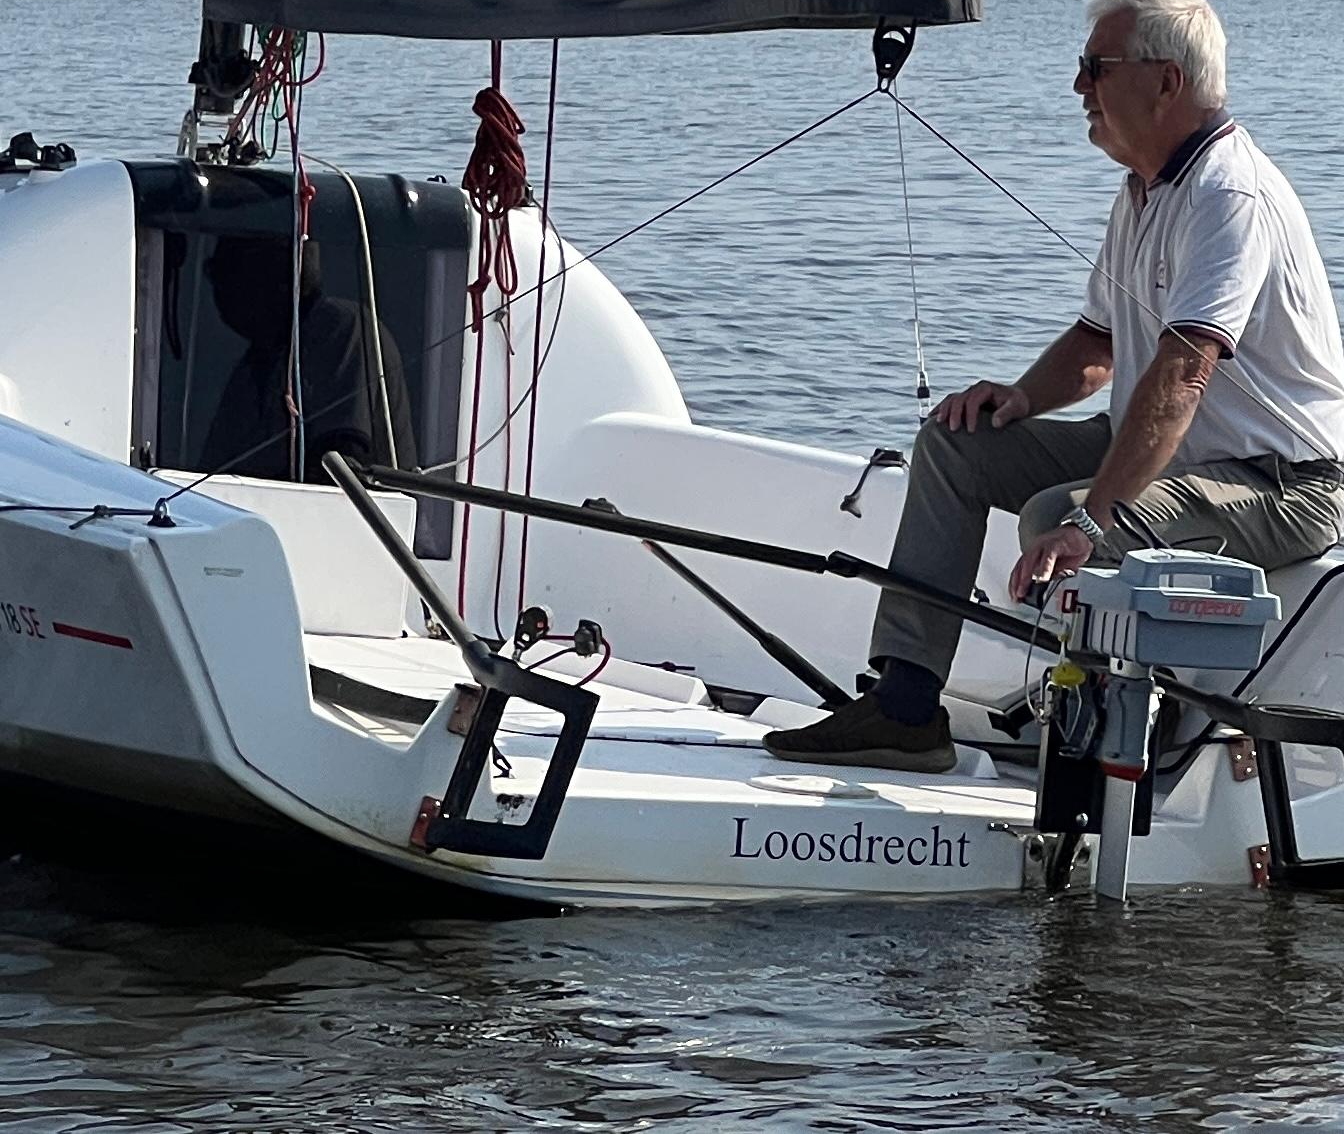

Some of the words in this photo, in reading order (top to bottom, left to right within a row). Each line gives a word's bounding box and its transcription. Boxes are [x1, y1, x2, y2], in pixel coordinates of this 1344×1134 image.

[1, 601, 22, 634] 18
[19, 605, 47, 640] SE
[730, 817, 971, 868] Loosdrecht
